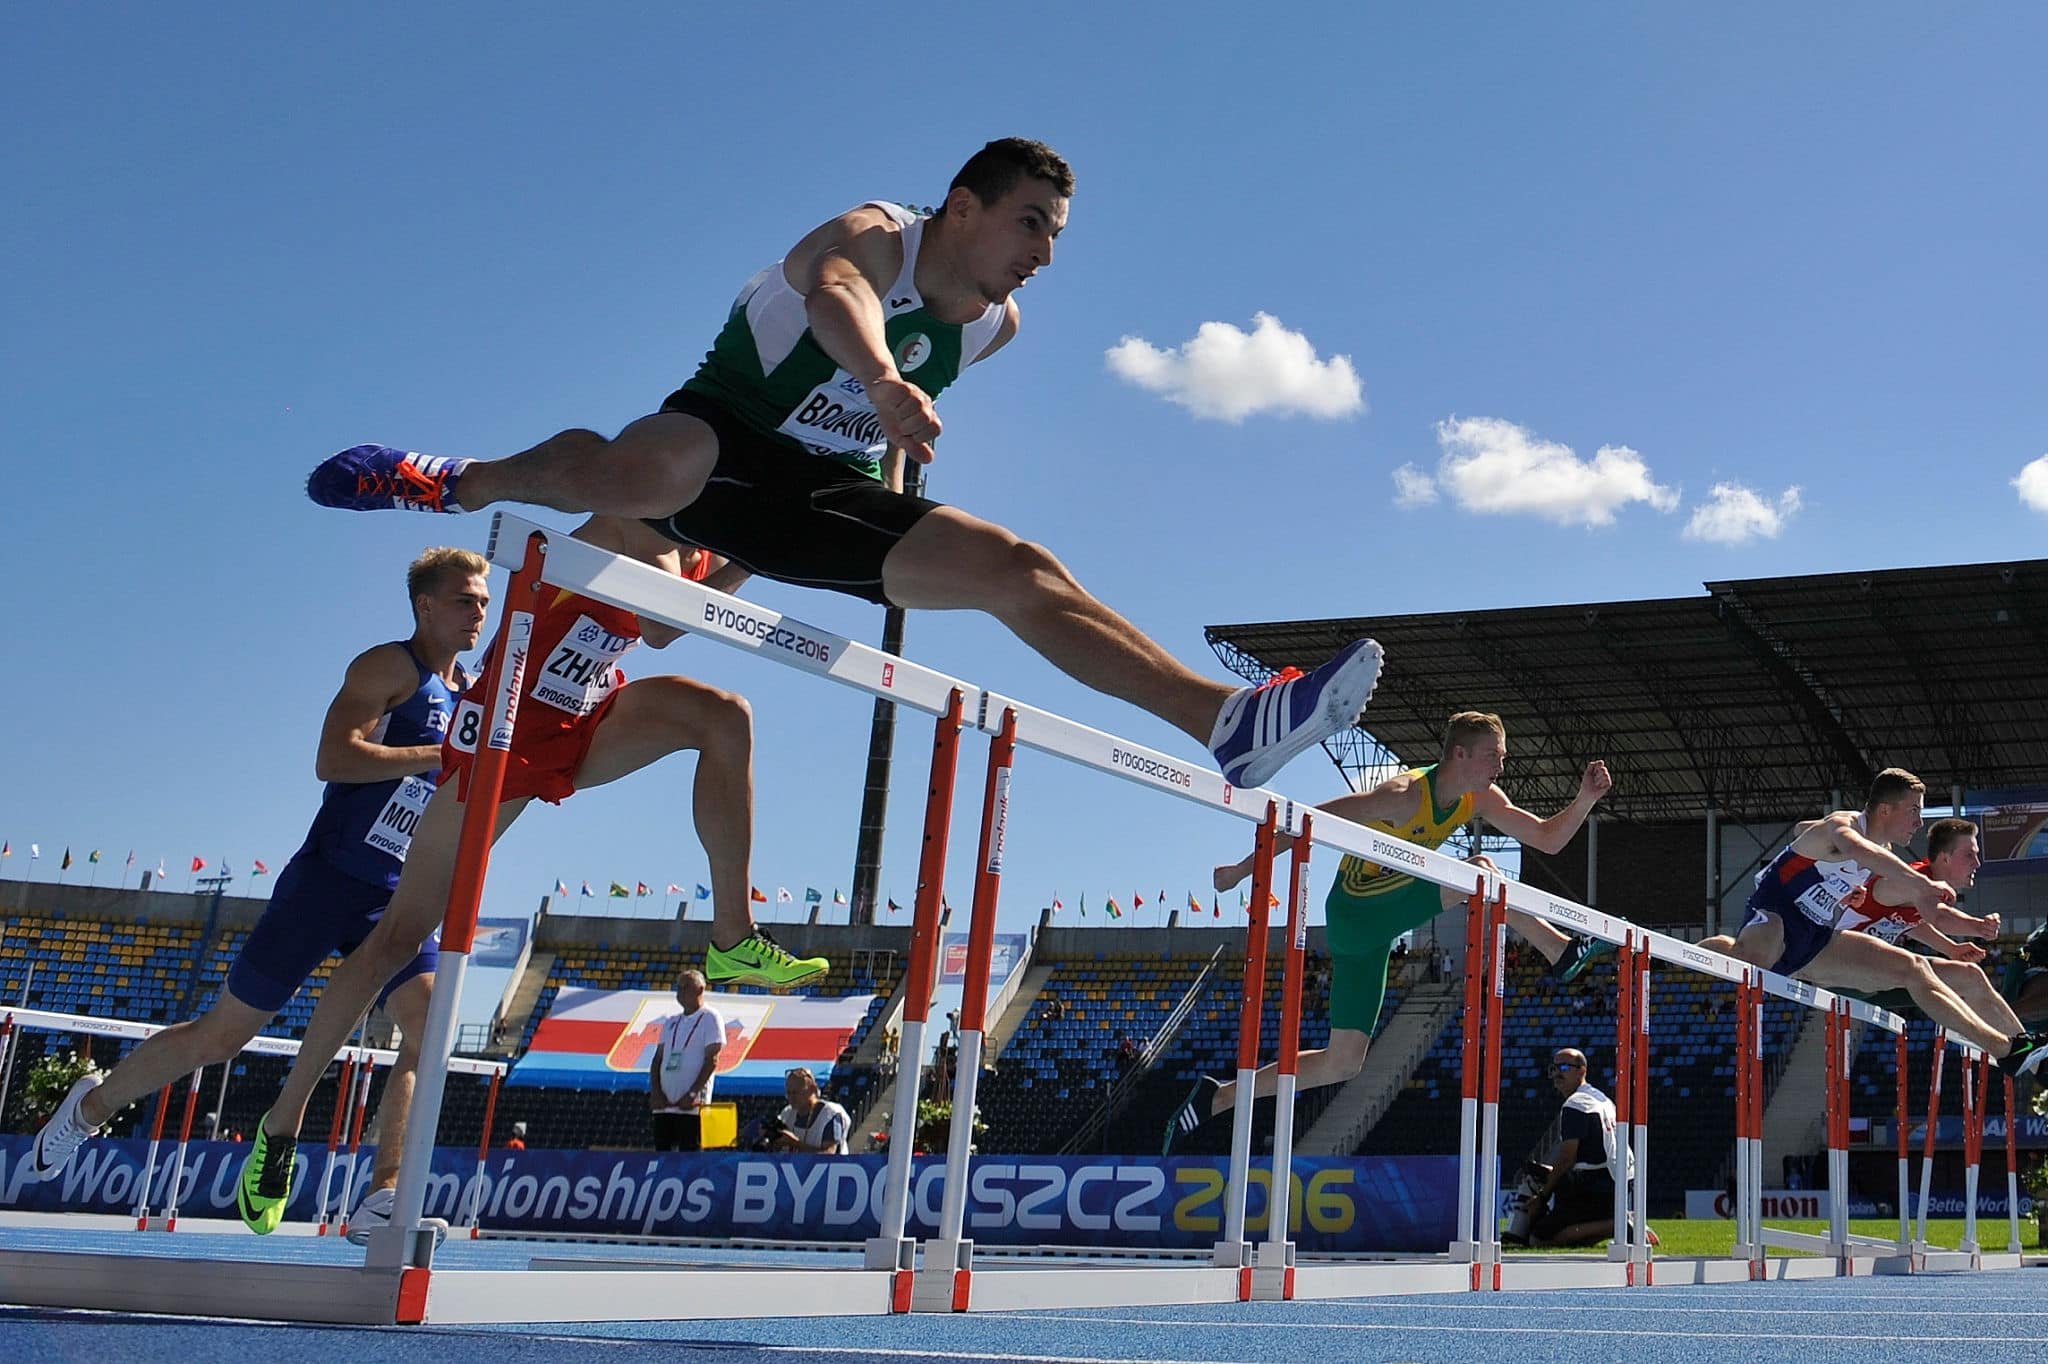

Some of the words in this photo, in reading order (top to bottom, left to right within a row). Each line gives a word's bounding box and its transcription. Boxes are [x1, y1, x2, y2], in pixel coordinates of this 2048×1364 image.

[704, 603, 796, 650] BYDGOSZCZ
[796, 637, 830, 663] 2016
[505, 648, 526, 723] polanik
[425, 709, 450, 734] ES
[459, 710, 479, 746] 8
[1112, 748, 1170, 780] BYDGOSZCZ
[1169, 769, 1191, 787] 2016
[381, 801, 421, 837] MOL
[61, 1148, 206, 1207] World
[1714, 1193, 1819, 1219] Cnon
